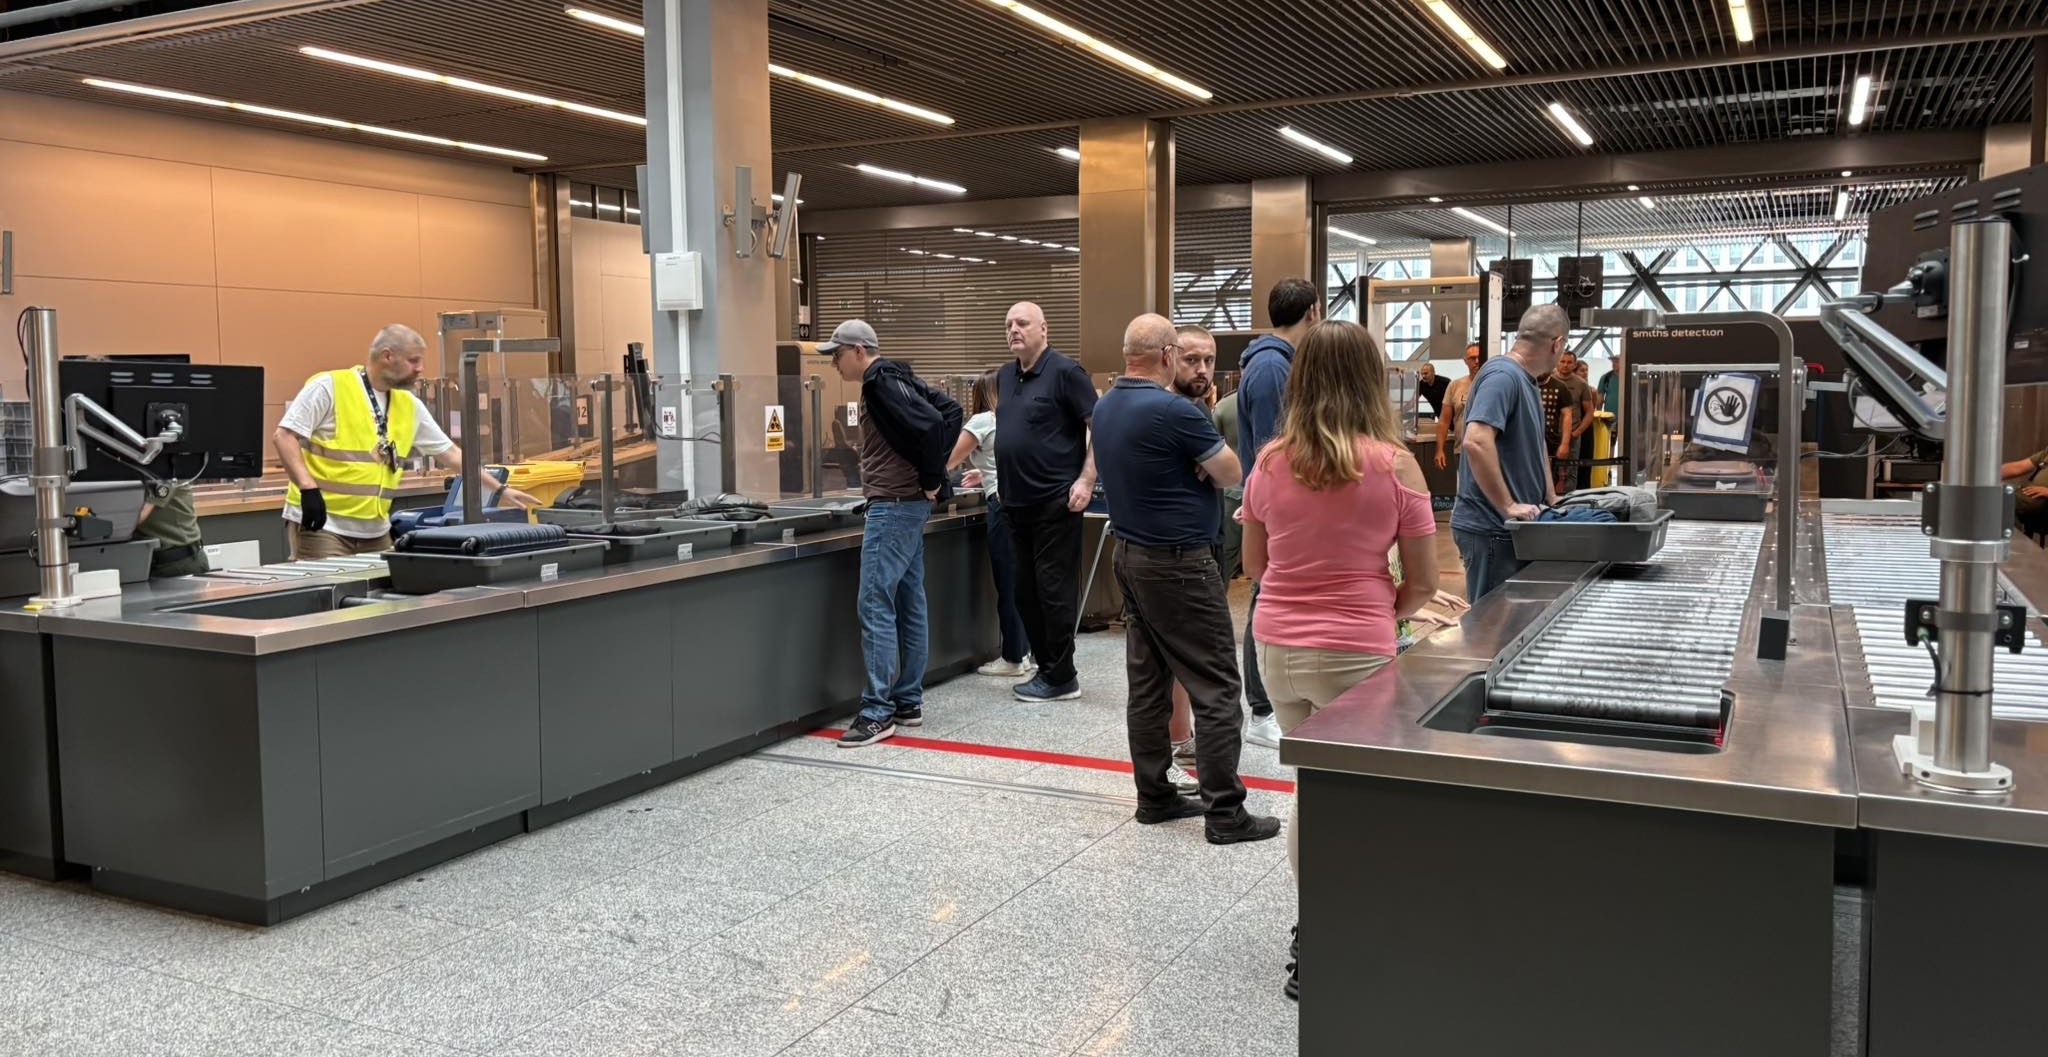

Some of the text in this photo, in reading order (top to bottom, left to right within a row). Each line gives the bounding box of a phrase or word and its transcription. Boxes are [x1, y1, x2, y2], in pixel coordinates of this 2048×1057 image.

[1632, 329, 1724, 338] smiths detection
[577, 406, 587, 418] 12
